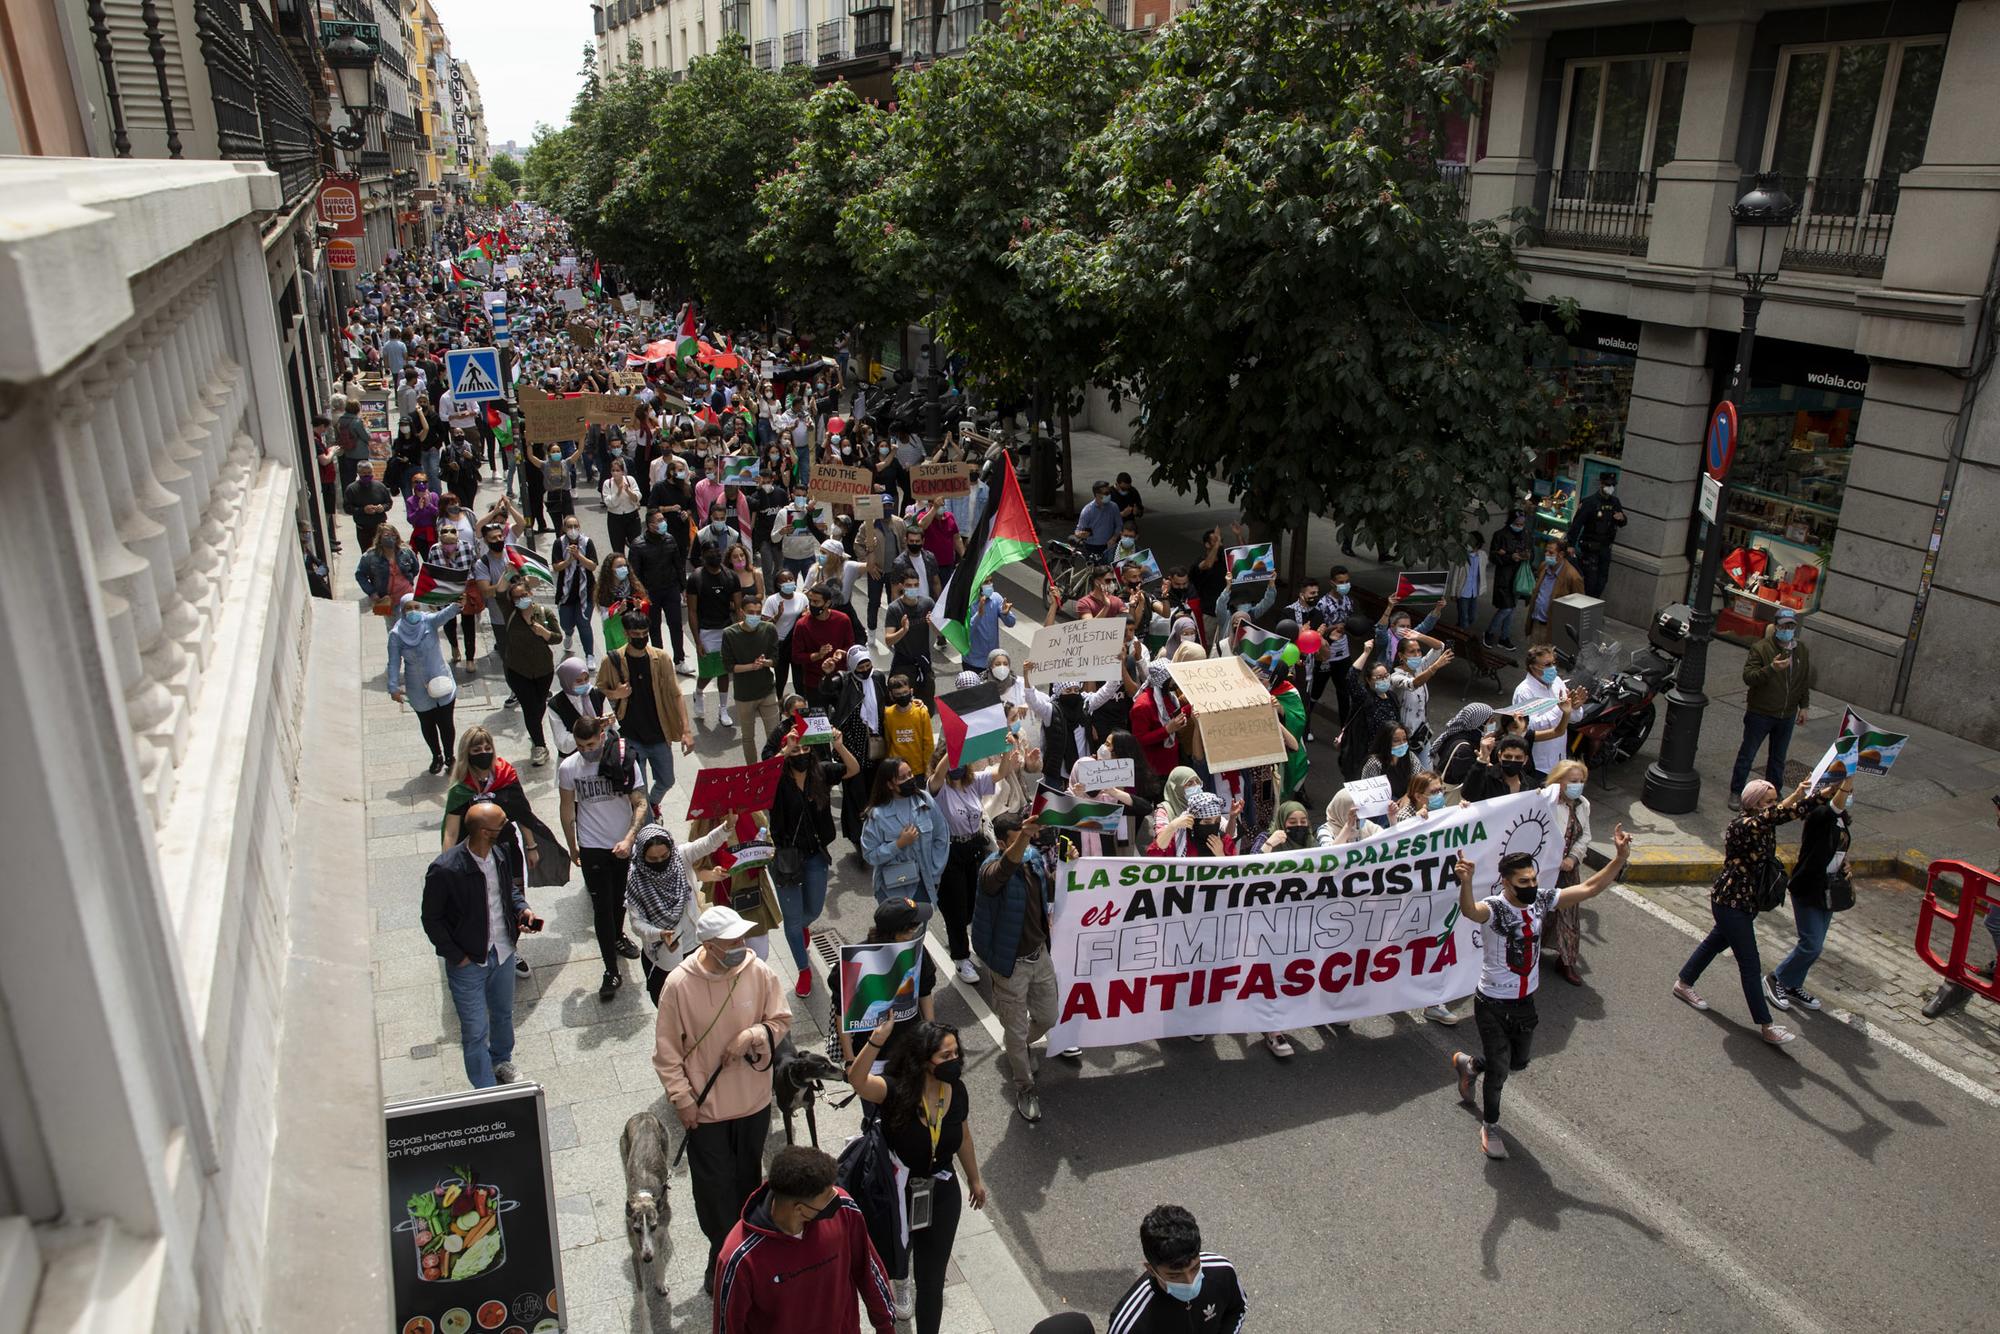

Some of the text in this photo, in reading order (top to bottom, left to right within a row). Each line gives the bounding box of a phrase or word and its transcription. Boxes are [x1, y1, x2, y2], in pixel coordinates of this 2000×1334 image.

[450, 59, 468, 165] MONUMENTAL
[329, 255, 356, 264] KING
[1598, 337, 1639, 351] wolala.co
[818, 466, 857, 480] END THE
[919, 463, 958, 476] STOP THE
[810, 478, 871, 495] OCCUPATION
[912, 478, 970, 495] GENOCIDE
[1063, 621, 1088, 634] PEACE
[1048, 629, 1119, 649] IN PALESTINE
[1030, 657, 1073, 674] PALESTINE
[1076, 656, 1089, 668] IN
[1184, 680, 1217, 695] THIS
[1219, 680, 1233, 692] IS
[1066, 820, 1488, 892] LA SOLIDARIDAD PALESTINA
[1080, 854, 1462, 927] es ANTIRRACISTA
[1073, 895, 1433, 977] FEMINISTA
[1060, 930, 1458, 1024] ANTIFASCISTA
[849, 1018, 878, 1030] FRANJA
[388, 1120, 507, 1149] Sopas hechas cada día
[403, 1138, 466, 1156] ingredientes
[468, 1129, 516, 1145] naturales
